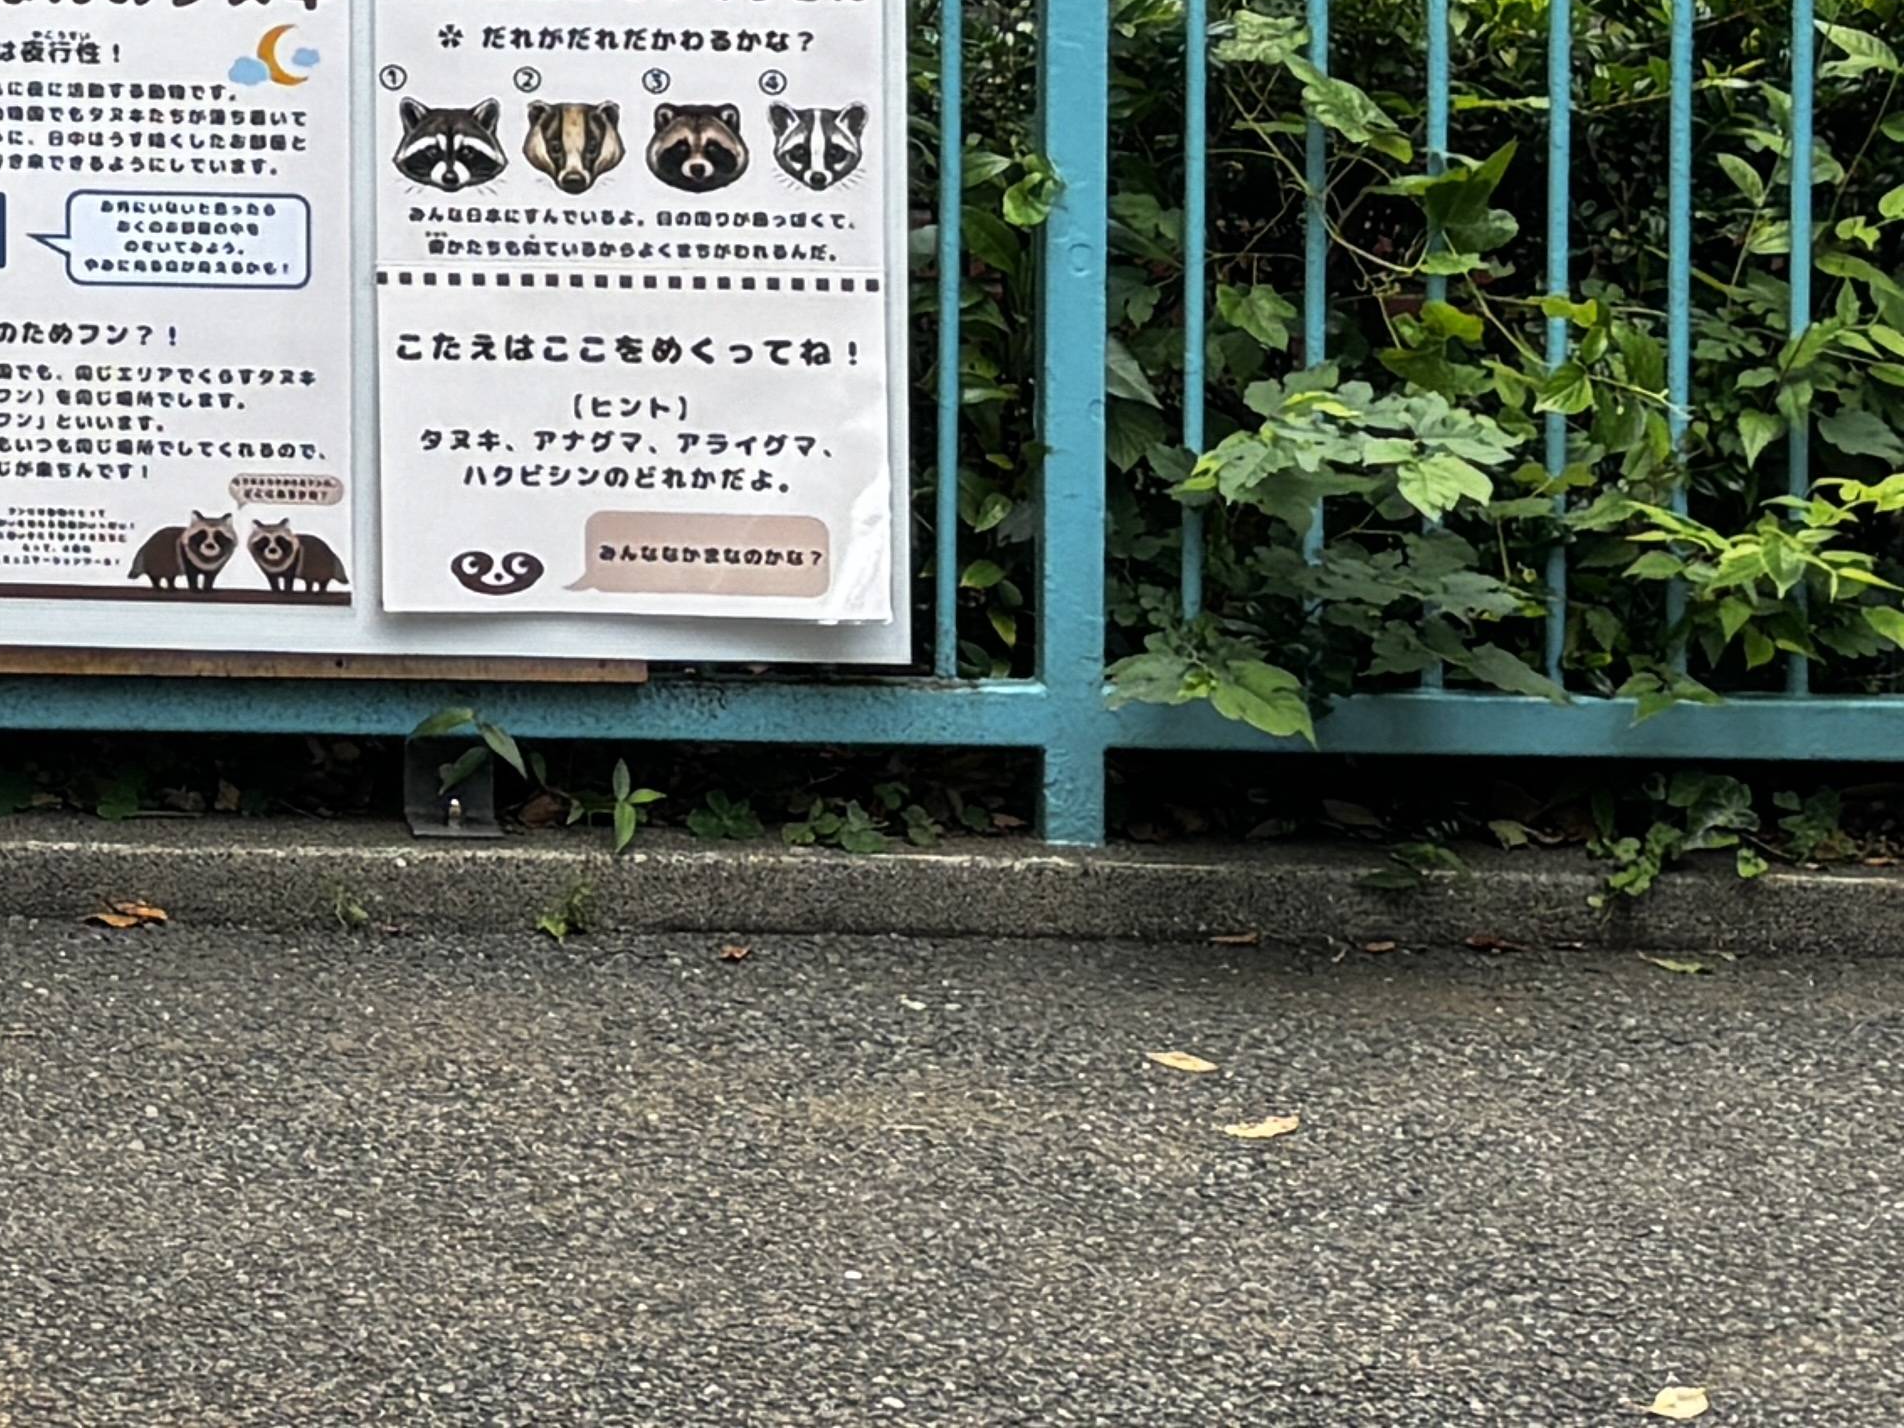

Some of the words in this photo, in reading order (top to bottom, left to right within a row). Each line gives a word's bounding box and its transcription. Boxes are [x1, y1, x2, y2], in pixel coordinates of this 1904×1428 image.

[482, 27, 814, 53] だれがだれだかわるかな？
[396, 332, 860, 367] こたえはここをめくってね！
[420, 429, 834, 459] タヌキ、アナグマ、アライグマ、
[463, 464, 790, 494] ハクビシンのどれかだよ。
[599, 544, 824, 567] みんななかまなのかな？
